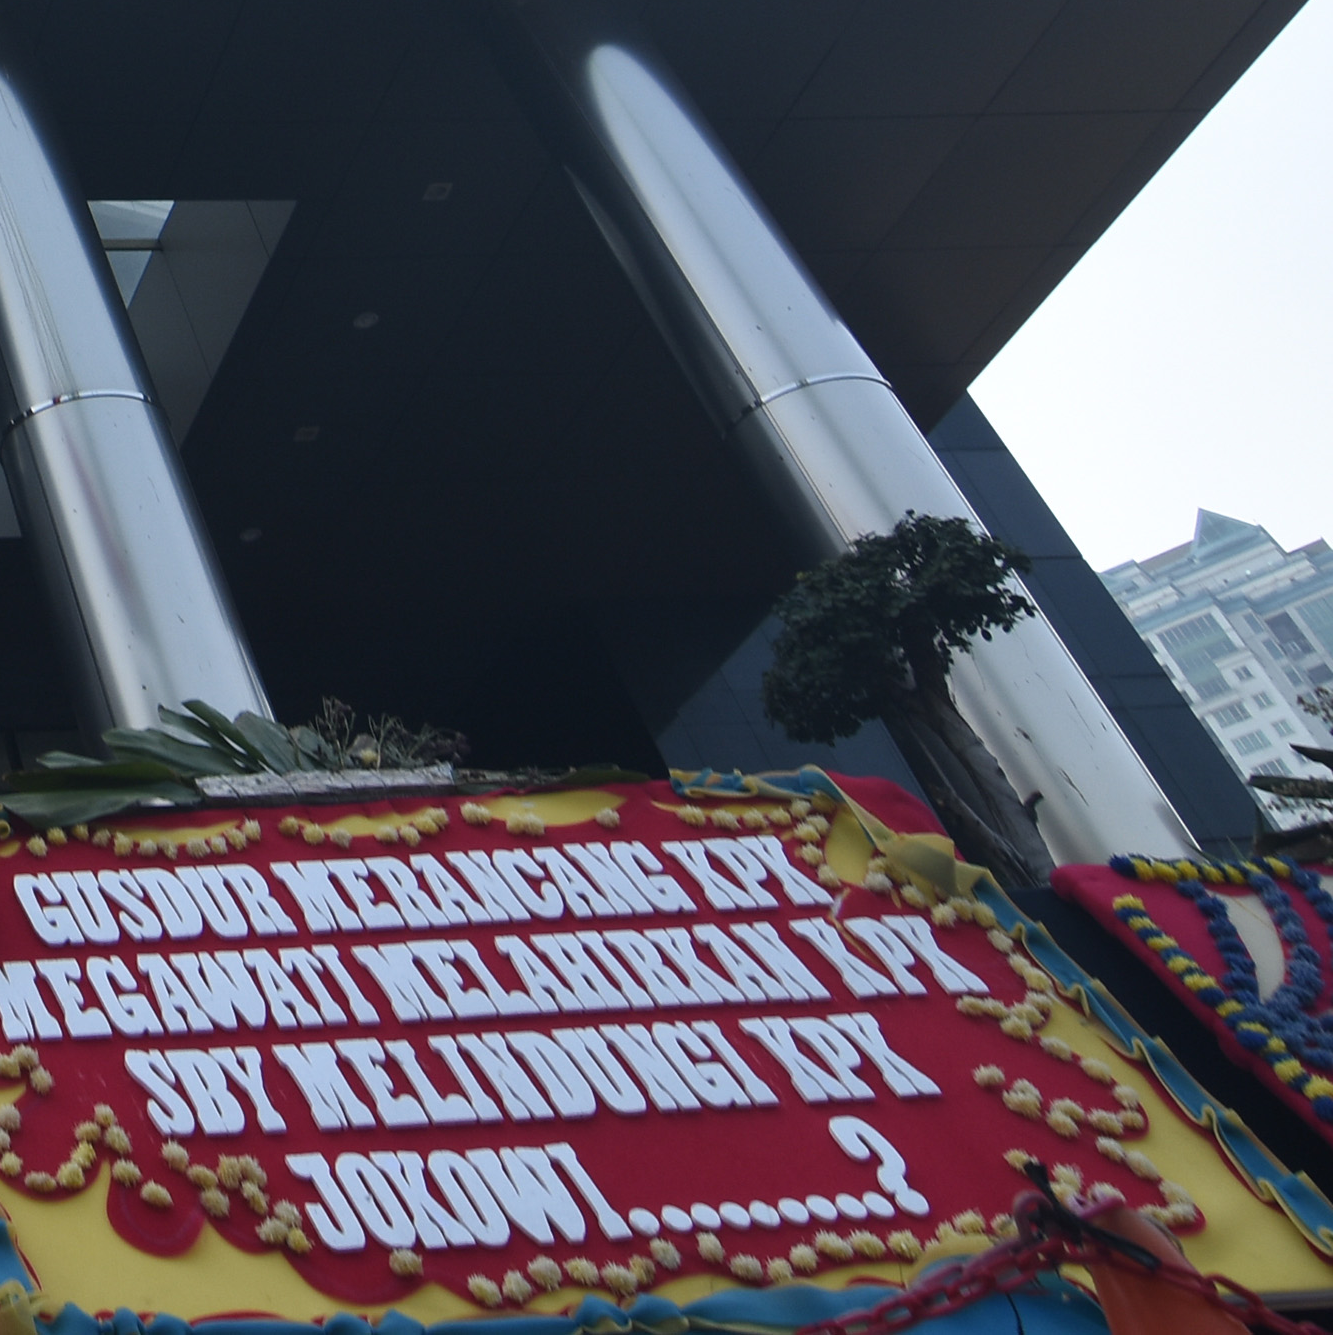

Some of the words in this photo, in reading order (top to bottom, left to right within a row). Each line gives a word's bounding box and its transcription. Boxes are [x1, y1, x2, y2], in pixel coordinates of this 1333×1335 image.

[13, 864, 299, 948] GUSDUR
[270, 840, 699, 934] MERANCANG
[662, 834, 843, 916] KPK
[351, 920, 832, 1024] MELAHIRKAN
[790, 915, 991, 998] KPK
[124, 1047, 287, 1137] SBY
[272, 1019, 780, 1130] MELINDUNGI
[739, 1011, 943, 1103] KPK
